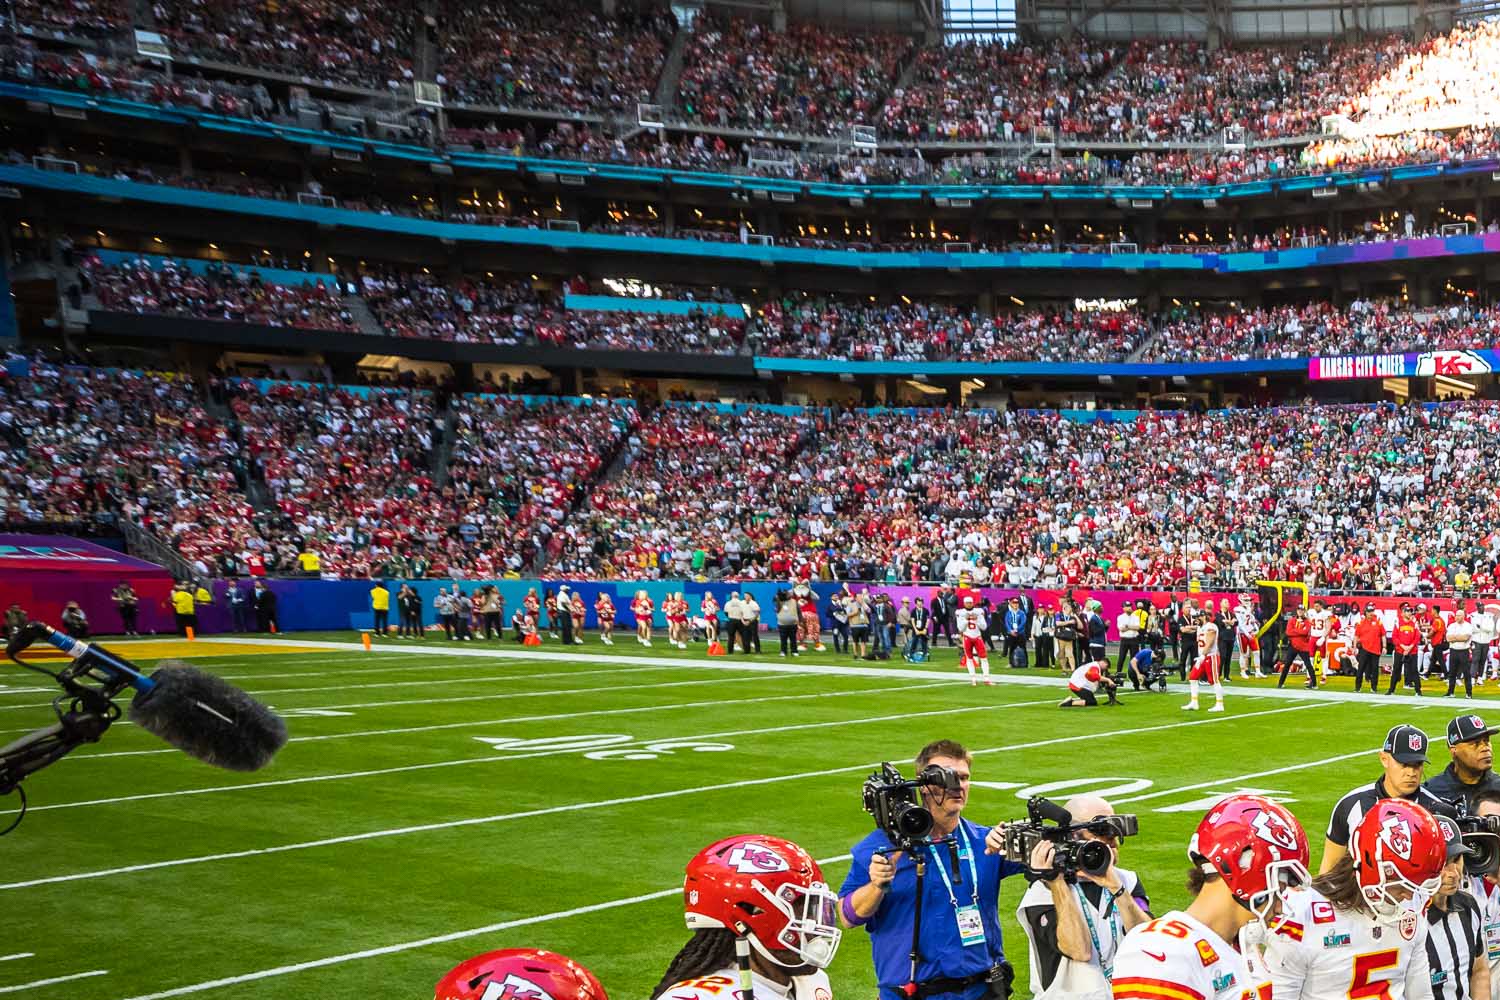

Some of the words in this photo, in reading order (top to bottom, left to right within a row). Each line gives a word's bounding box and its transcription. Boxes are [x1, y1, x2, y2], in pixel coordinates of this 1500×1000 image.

[1320, 356, 1354, 379] KANSAS
[1355, 355, 1376, 377] CITY
[1376, 353, 1405, 376] CHIEFS
[1310, 618, 1325, 631] 43
[744, 849, 781, 870] KC
[1314, 901, 1333, 918] C
[1141, 917, 1195, 940] 15
